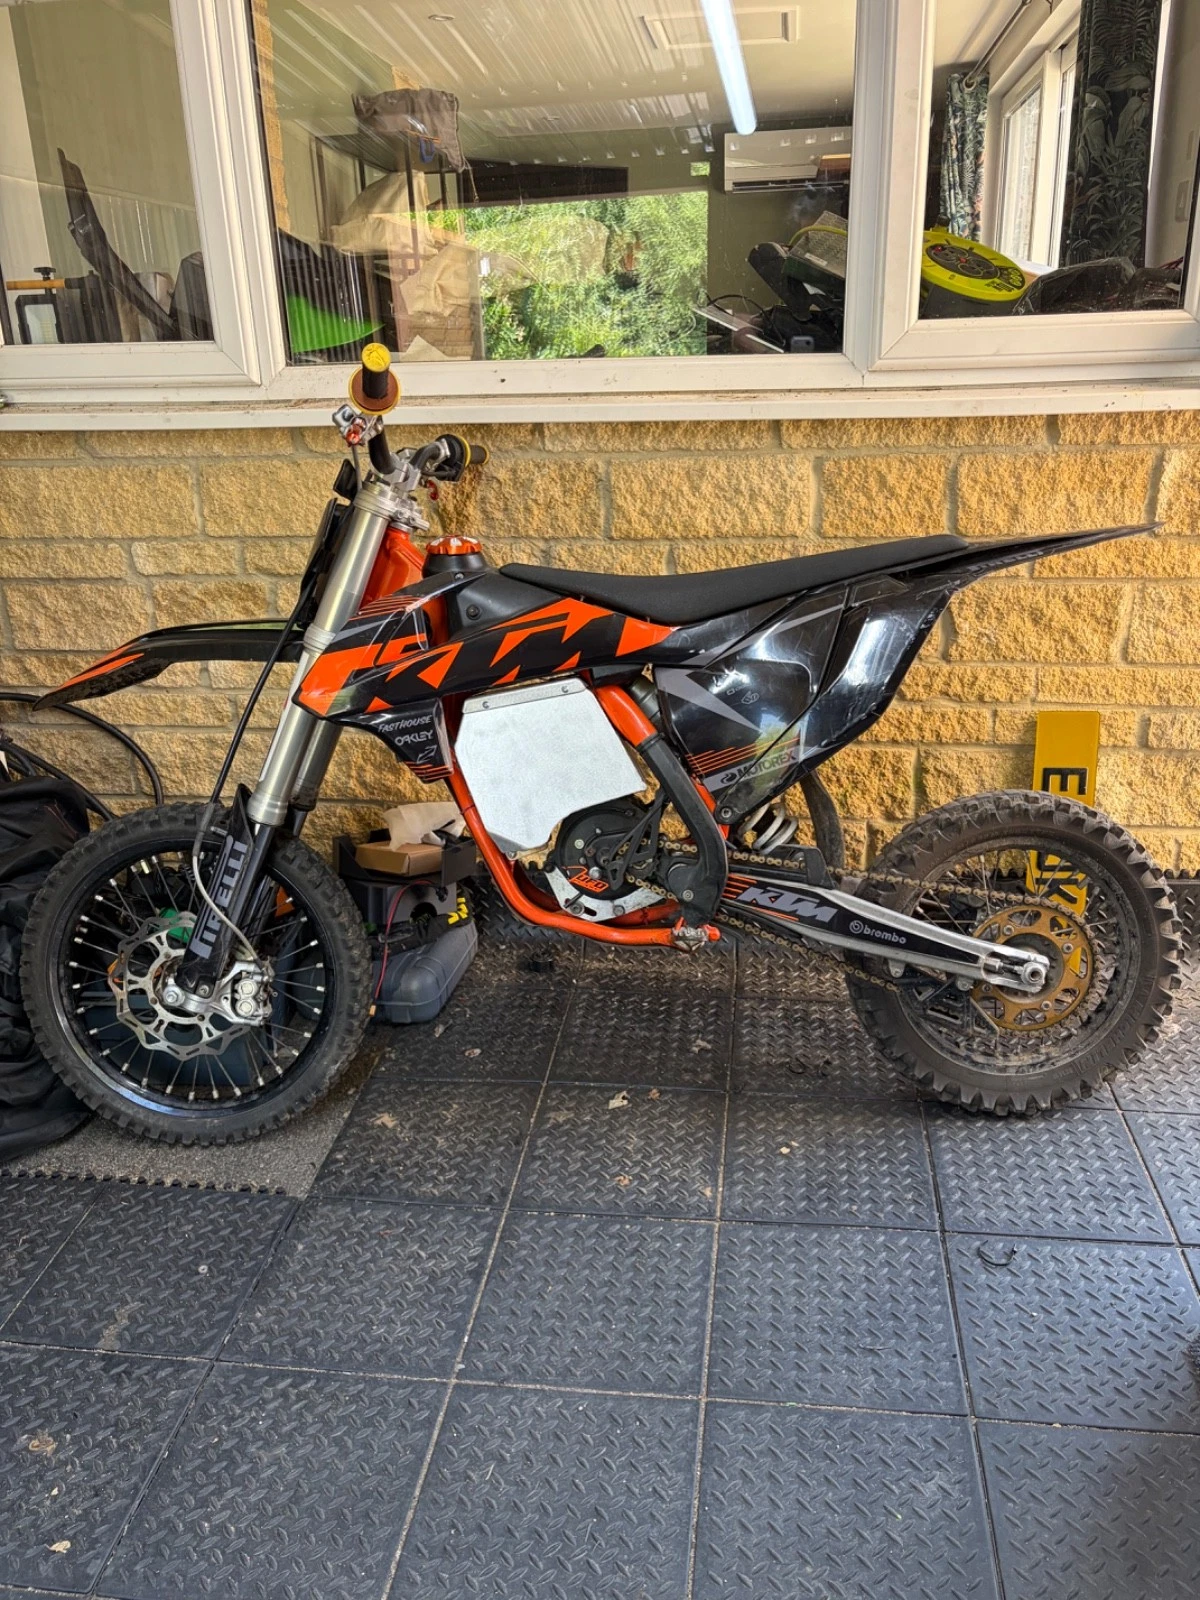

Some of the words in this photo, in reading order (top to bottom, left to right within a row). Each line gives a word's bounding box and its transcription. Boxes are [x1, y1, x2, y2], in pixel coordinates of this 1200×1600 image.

[378, 714, 433, 733] FASTHOUSE
[395, 729, 434, 746] OAKLEY
[736, 750, 797, 779] MOTOREX
[736, 886, 838, 923] KTM
[863, 924, 907, 945] brembo
